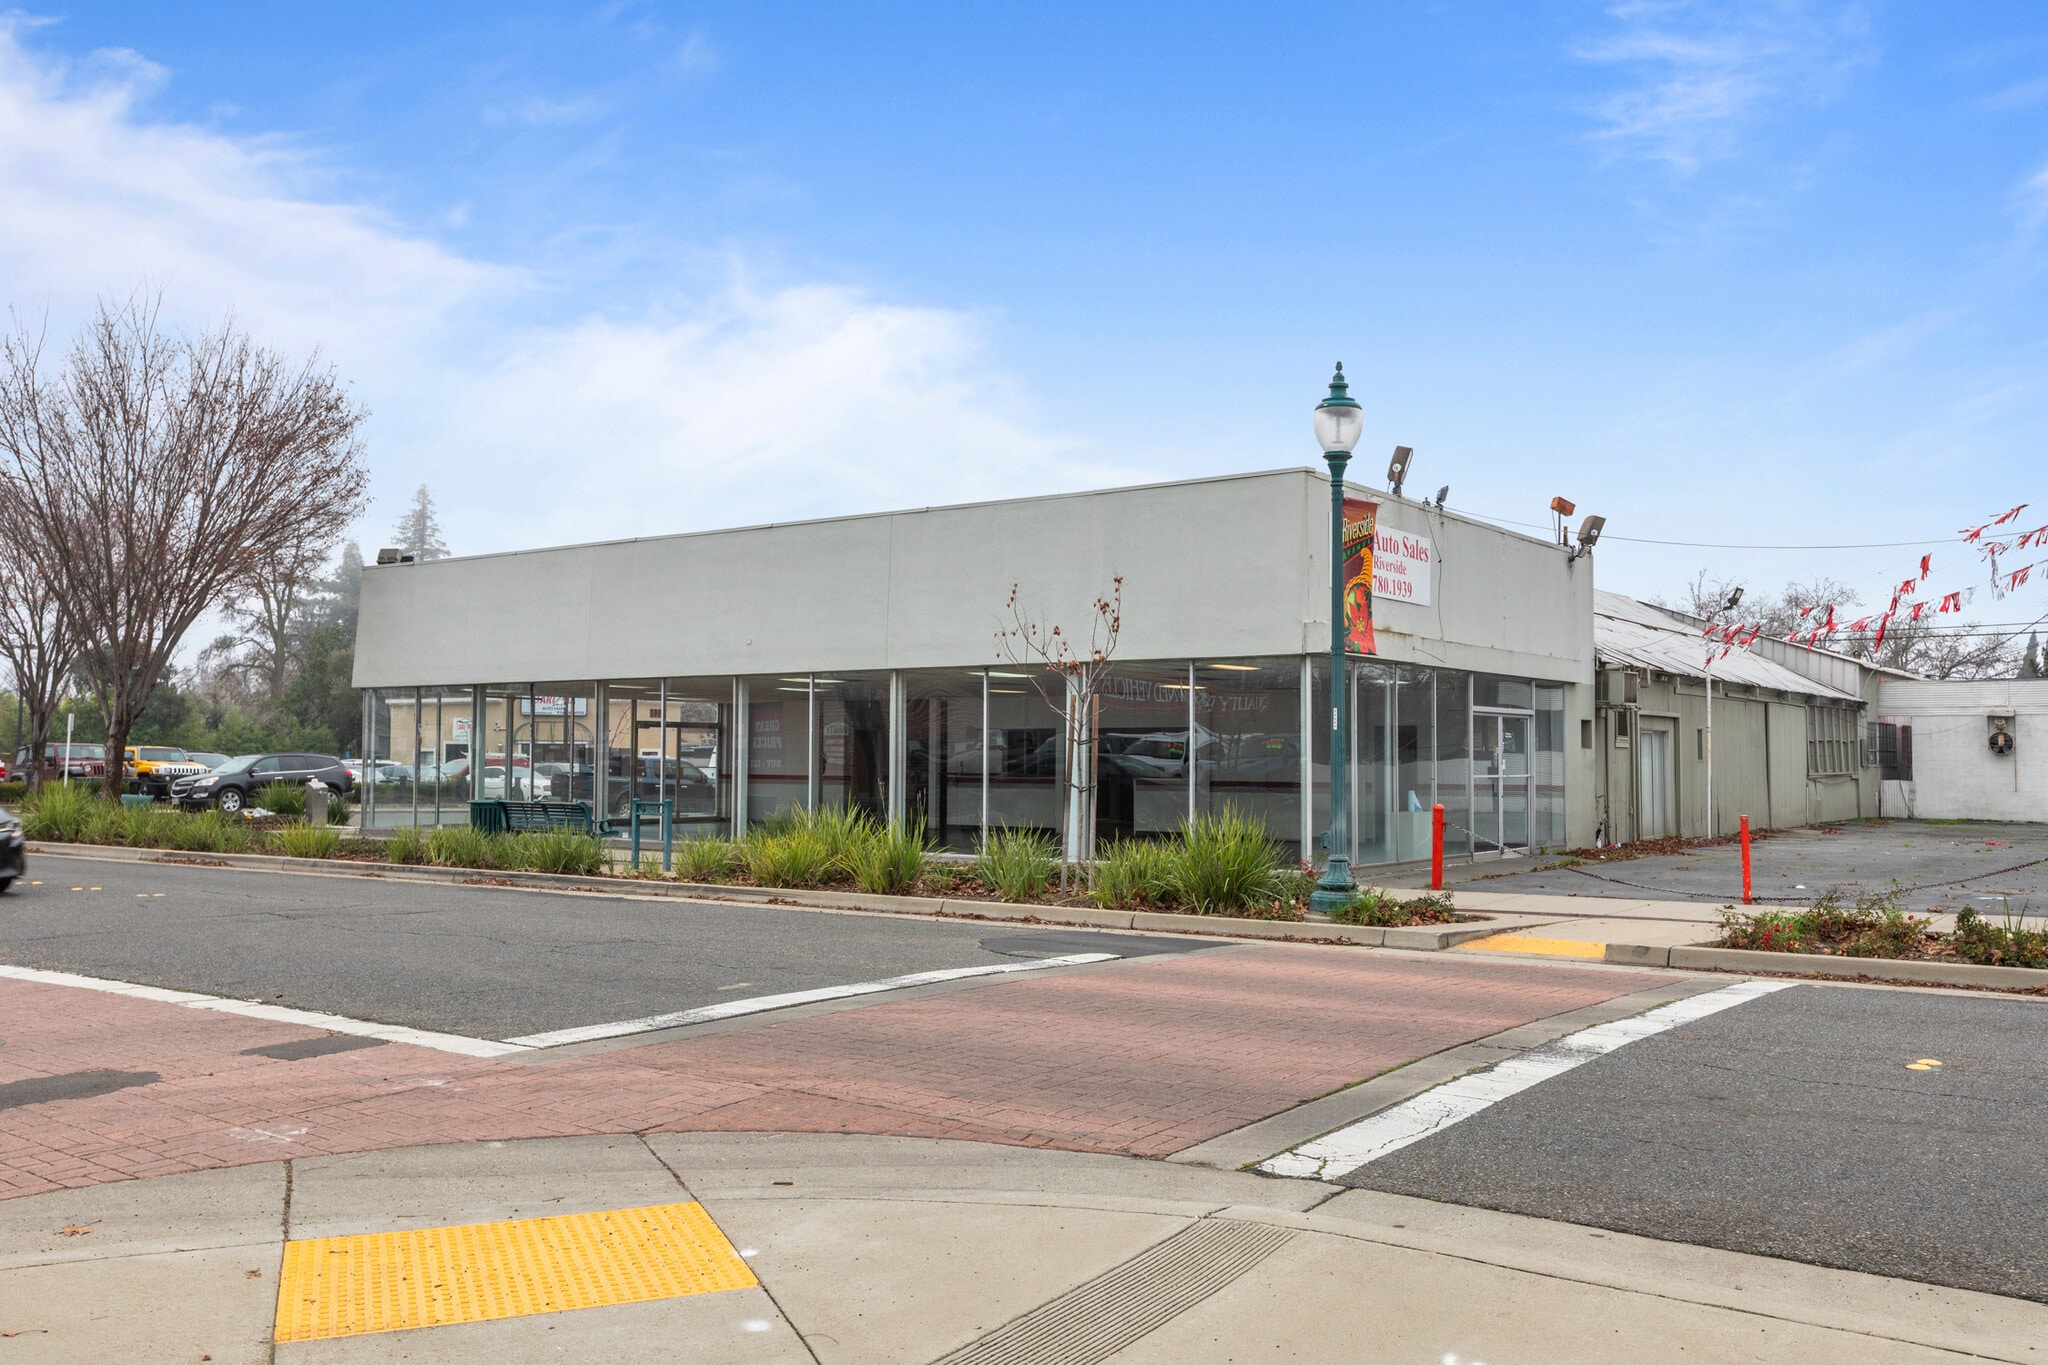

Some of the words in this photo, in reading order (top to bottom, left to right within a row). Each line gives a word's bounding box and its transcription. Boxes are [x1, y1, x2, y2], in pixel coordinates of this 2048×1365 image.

[1342, 513, 1374, 543] Riverside
[1343, 538, 1371, 561] AVENUE
[1374, 529, 1399, 555] Auto
[1402, 535, 1429, 563] Sales
[1373, 555, 1407, 576] Riverside
